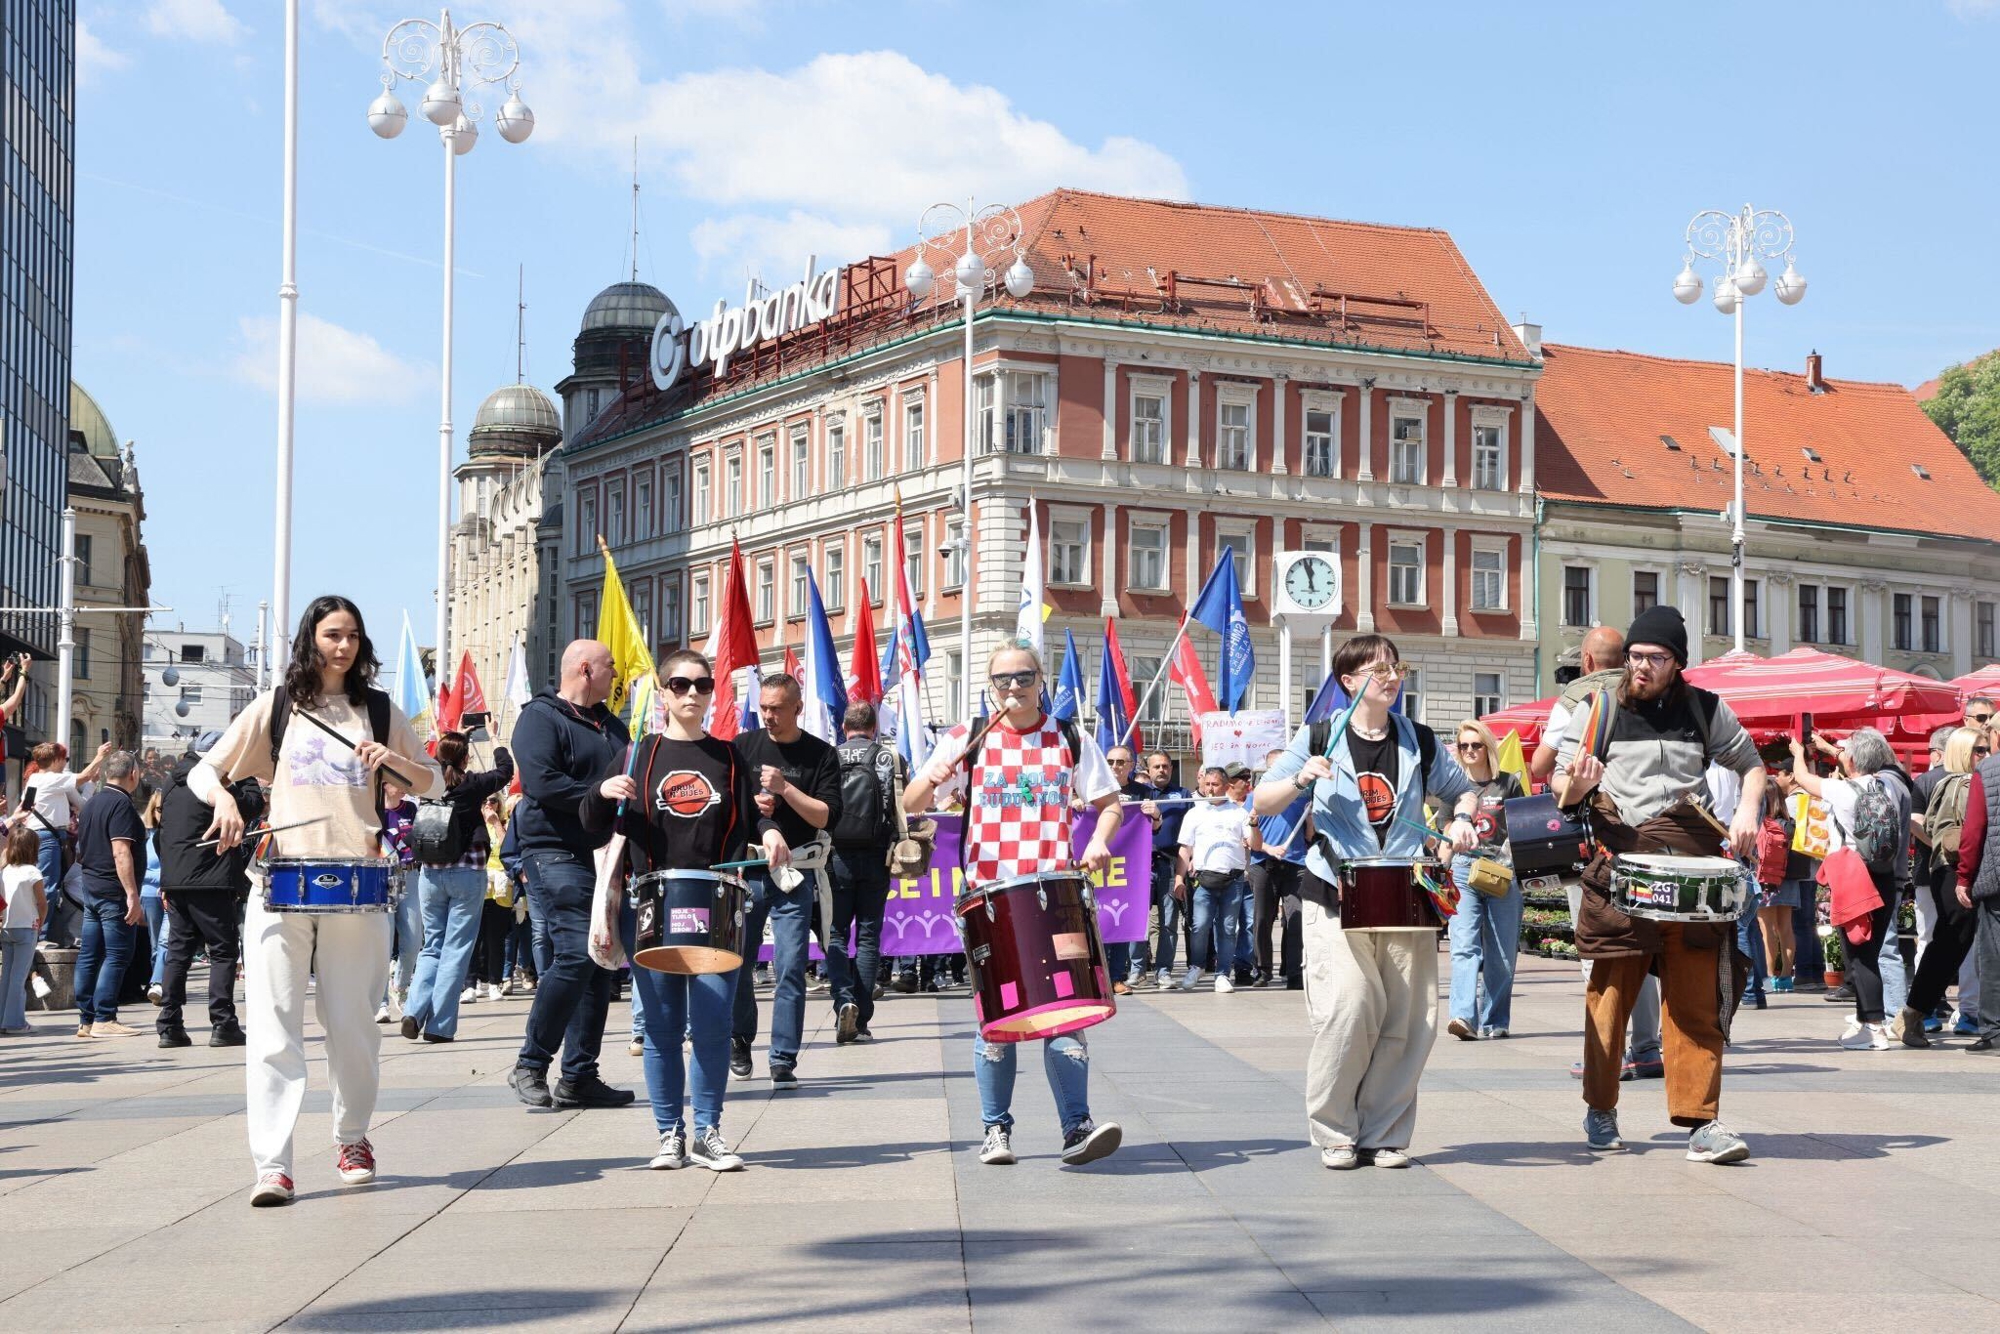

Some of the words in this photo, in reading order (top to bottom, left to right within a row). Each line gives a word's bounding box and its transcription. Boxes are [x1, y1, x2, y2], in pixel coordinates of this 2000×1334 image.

[984, 771, 1008, 788] ZA
[671, 784, 695, 792] DRUM
[680, 789, 704, 798] BIJES
[1653, 881, 1671, 892] ZG
[1652, 894, 1672, 904] 041
